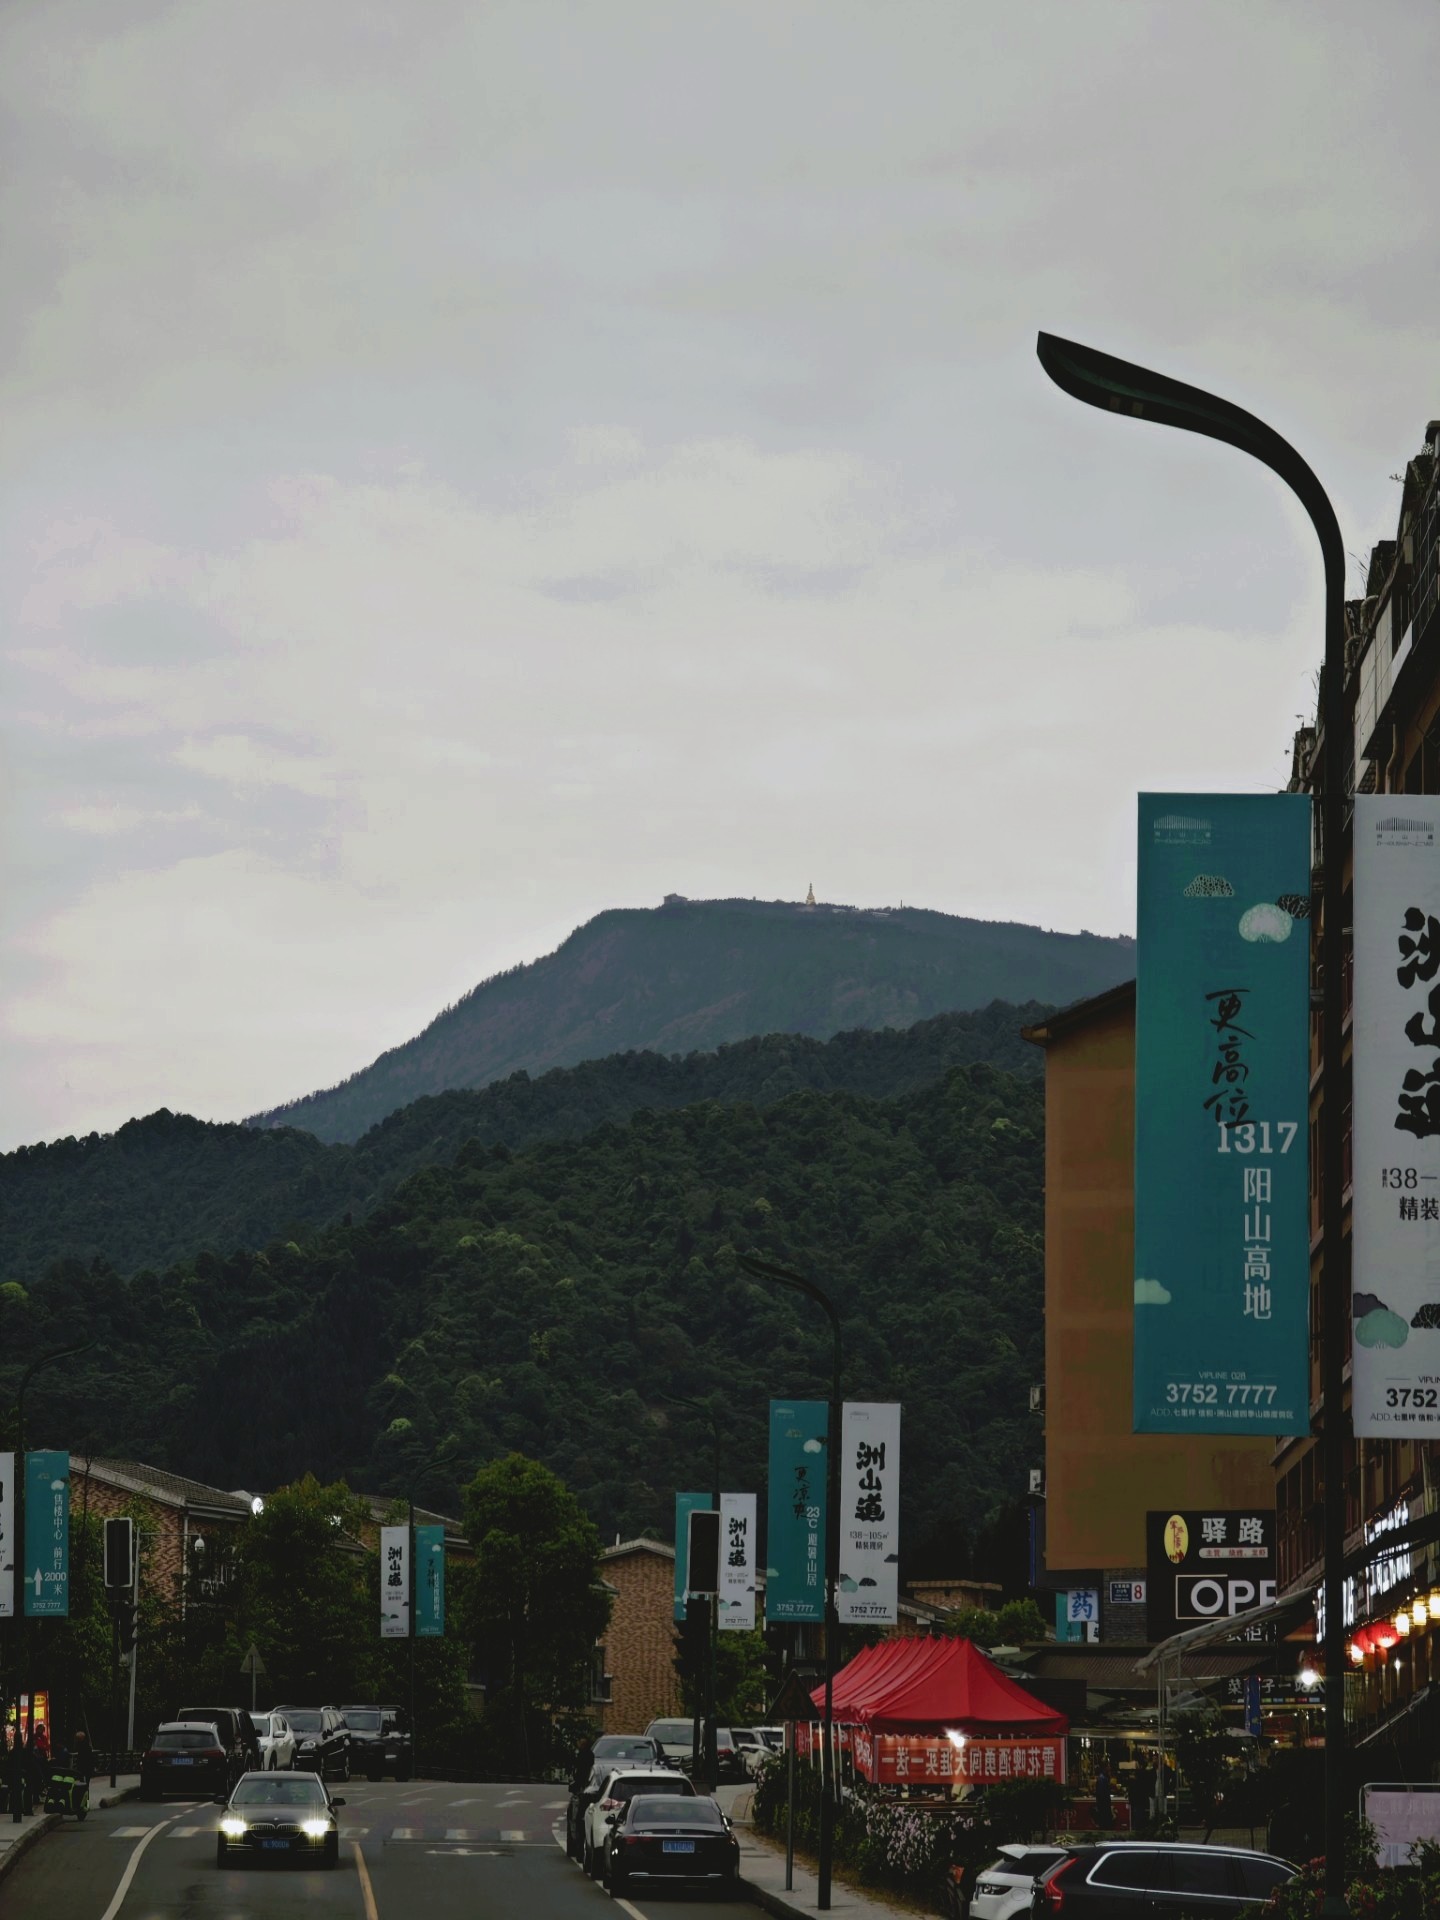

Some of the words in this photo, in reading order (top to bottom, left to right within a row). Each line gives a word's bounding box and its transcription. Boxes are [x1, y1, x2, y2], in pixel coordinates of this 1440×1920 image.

[1217, 1121, 1298, 1153] 1317
[1400, 1196, 1439, 1221] 精装
[1243, 1167, 1272, 1320] 阳山高地
[1198, 1371, 1228, 1380] VIPLINE
[1165, 1383, 1218, 1404] 3752
[1225, 1384, 1278, 1405] 7777
[1386, 1388, 1438, 1408] 3752
[855, 1441, 886, 1523] 洲山道
[53, 1493, 63, 1540] 售楼中心
[728, 1517, 747, 1567] 洲山道
[1201, 1517, 1264, 1544] 驿路
[53, 1546, 63, 1570] 前行
[388, 1546, 403, 1587] 洲山道
[44, 1572, 66, 1581] 2000
[53, 1584, 63, 1595] 米
[1134, 1585, 1143, 1600] 8
[776, 1603, 794, 1612] 3752
[796, 1604, 815, 1613] 7777
[850, 1606, 867, 1614] 3752
[870, 1606, 887, 1615] 7777
[1072, 1591, 1093, 1620] 药
